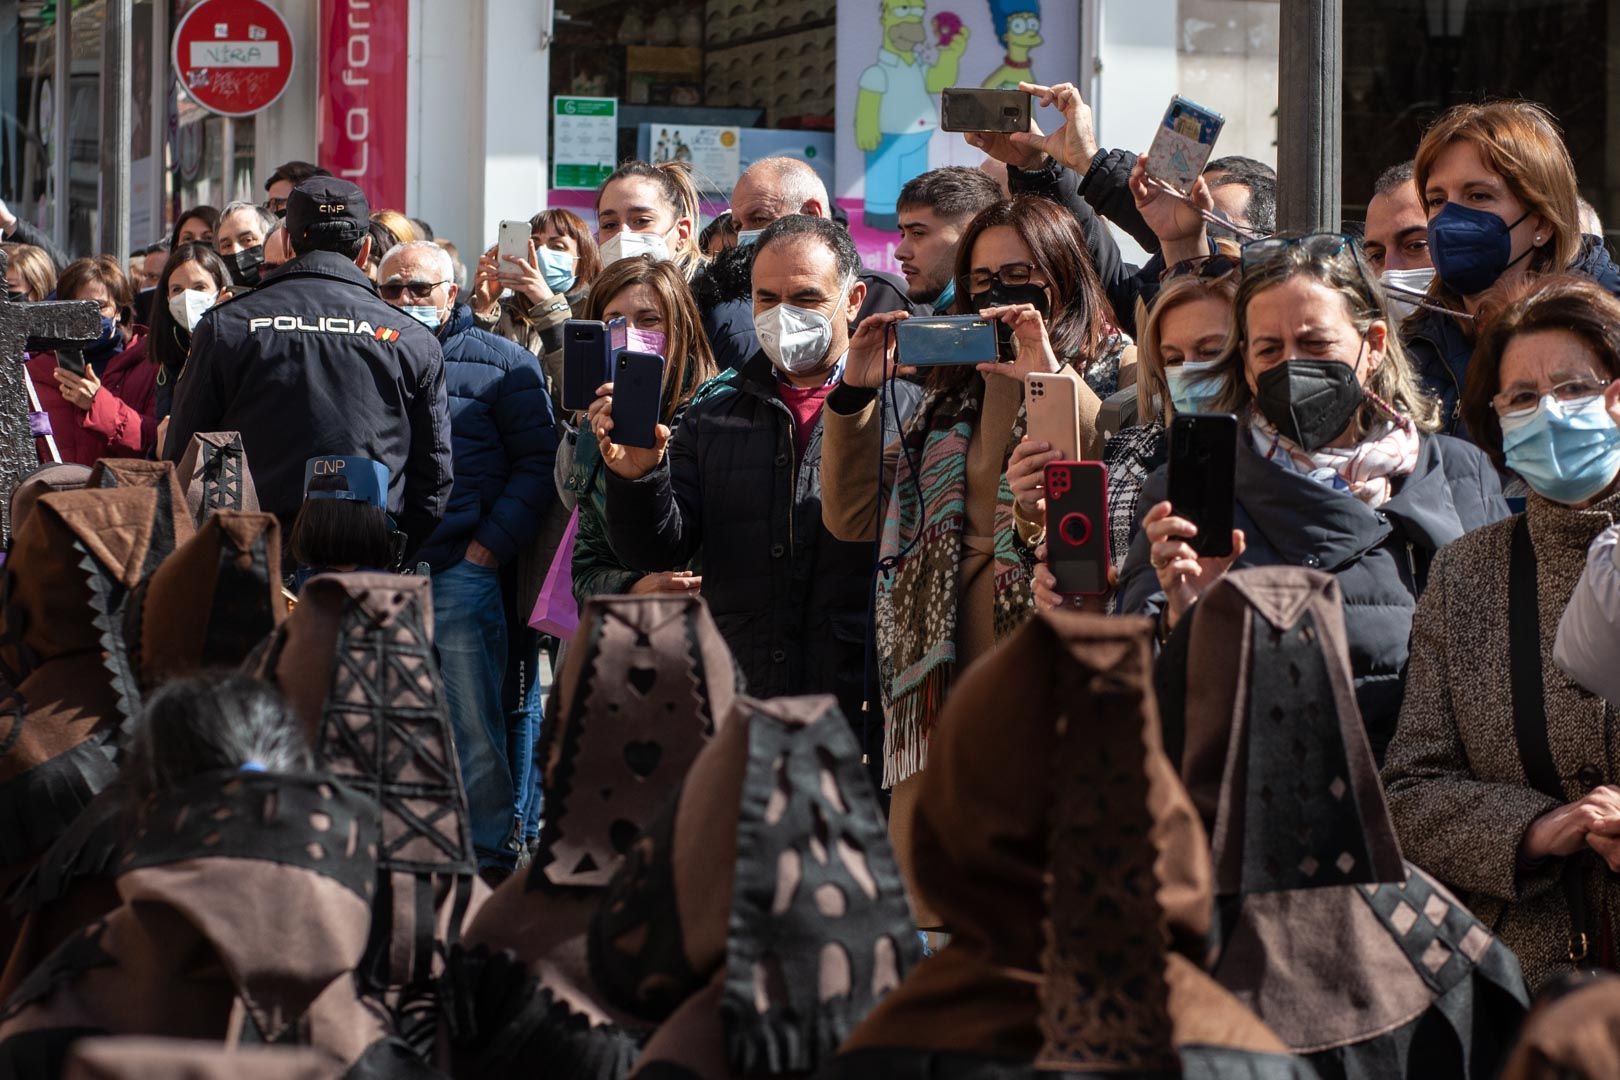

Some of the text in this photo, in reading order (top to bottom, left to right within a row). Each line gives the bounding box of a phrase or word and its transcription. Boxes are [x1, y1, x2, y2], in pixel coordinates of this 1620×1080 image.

[341, 108, 369, 177] La
[319, 204, 345, 214] CNP
[250, 315, 376, 337] POLICIA
[313, 459, 346, 475] CNP
